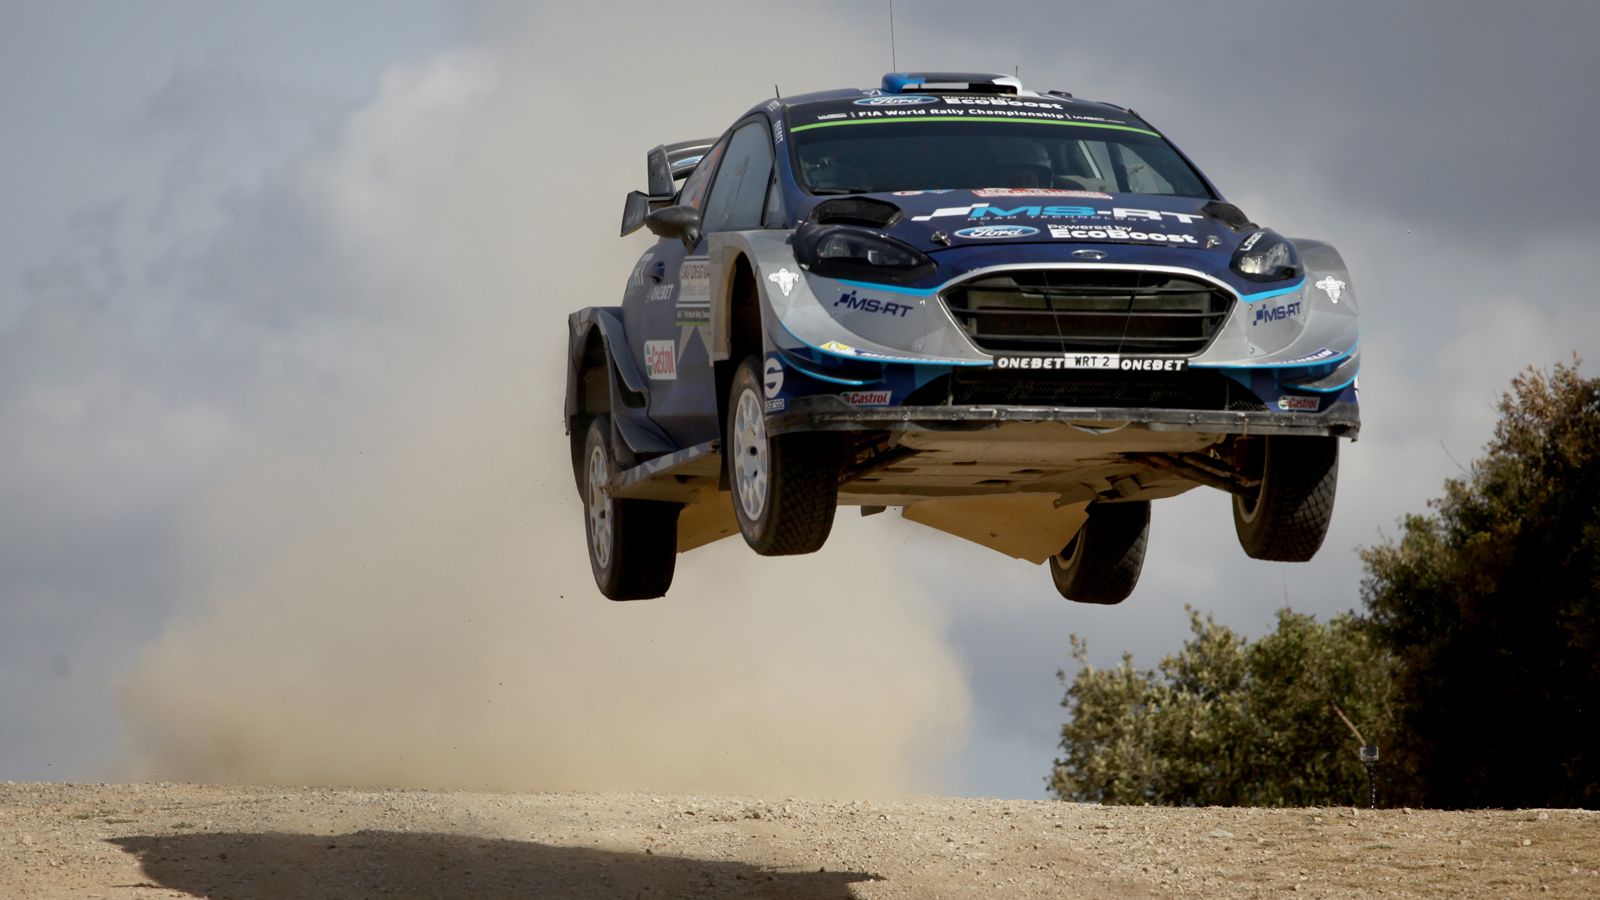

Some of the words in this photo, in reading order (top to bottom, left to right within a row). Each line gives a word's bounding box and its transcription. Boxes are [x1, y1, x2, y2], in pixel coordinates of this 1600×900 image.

[943, 99, 1064, 110] EcoBoost
[884, 109, 926, 117] World
[968, 108, 1065, 119] Championship
[968, 205, 1205, 224] MS-RT
[1047, 224, 1112, 232] Powered
[1115, 224, 1133, 233] by
[1049, 228, 1199, 244] EcoBoost
[846, 296, 914, 318] MS-RT
[1263, 301, 1302, 323] MS-RT
[651, 345, 676, 375] Castrol
[997, 357, 1064, 369] ONEBET
[1074, 356, 1097, 367] WRT
[1103, 356, 1110, 367] 2
[1121, 359, 1186, 371] ONEBET
[850, 392, 888, 404] Castrol
[1288, 397, 1317, 409] Castrol
